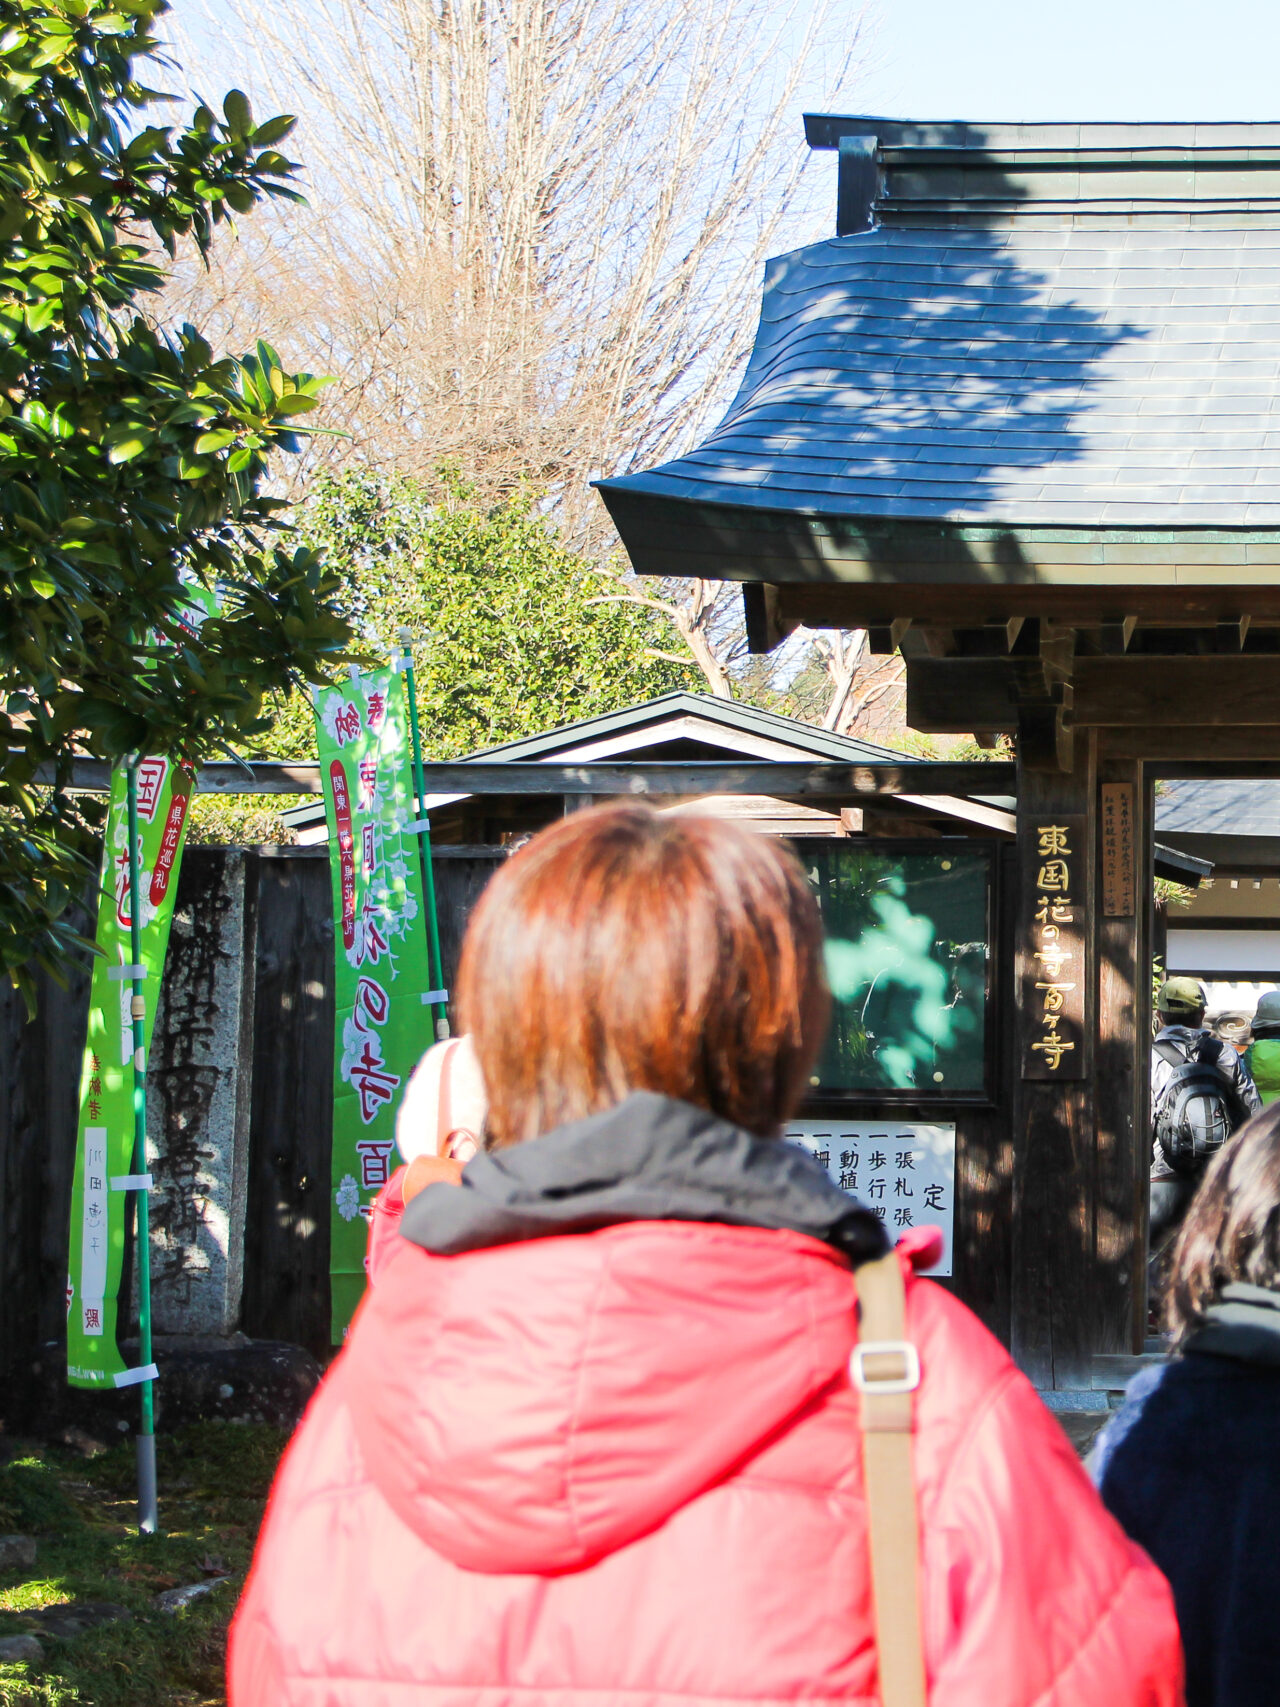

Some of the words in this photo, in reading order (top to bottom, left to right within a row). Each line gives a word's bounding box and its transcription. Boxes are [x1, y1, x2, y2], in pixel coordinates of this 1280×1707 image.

[1031, 824, 1077, 1071] 東国花の寺百ヶ寺
[923, 1184, 948, 1211] 定
